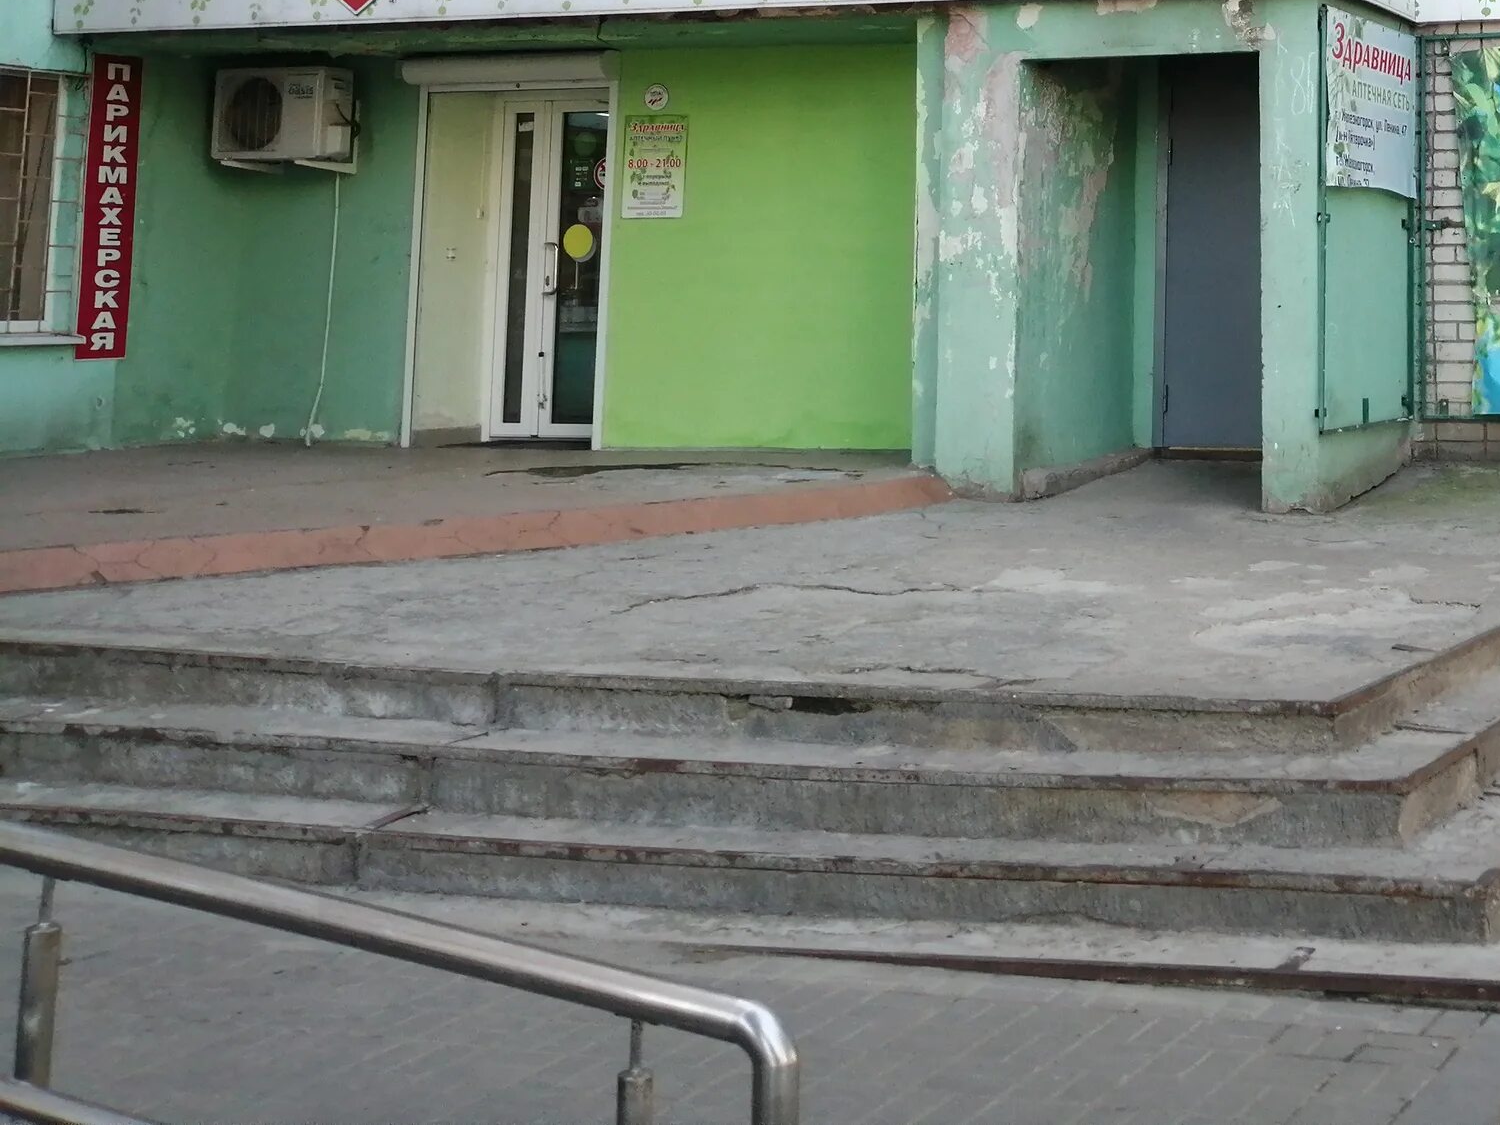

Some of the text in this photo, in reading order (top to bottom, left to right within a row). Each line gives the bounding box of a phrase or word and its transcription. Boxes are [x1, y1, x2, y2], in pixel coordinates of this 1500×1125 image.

[1332, 22, 1411, 85] ЗДРАВНИЦА
[1352, 80, 1410, 111] АПТЕЧНАЯ СЕТЬ
[628, 159, 648, 169] 8.00
[656, 158, 681, 168] 21.00
[90, 62, 131, 351] ПАРИКМАХЕРСКАЯ
